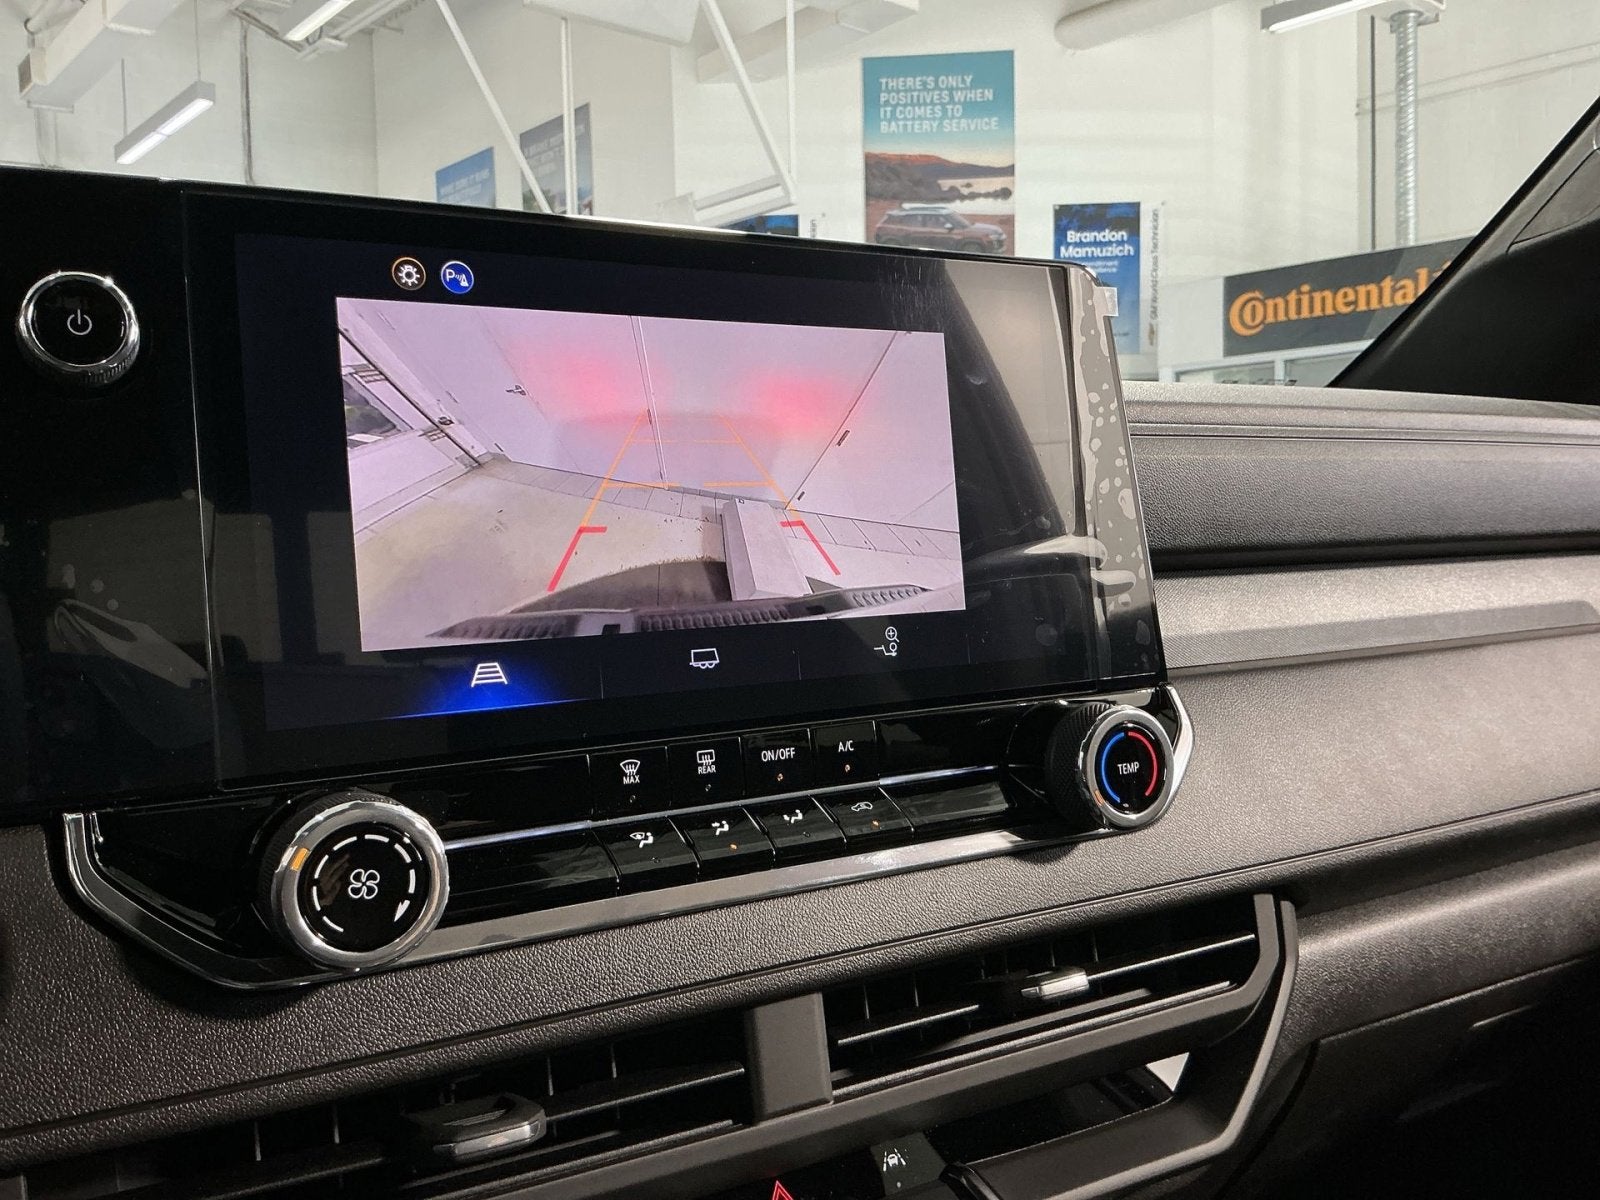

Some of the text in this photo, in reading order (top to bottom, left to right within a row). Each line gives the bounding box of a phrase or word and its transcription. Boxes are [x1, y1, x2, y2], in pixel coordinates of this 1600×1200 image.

[879, 74, 973, 91] THERE'S ONLY
[880, 88, 994, 105] POSITIVES WHEN
[880, 104, 963, 119] IT COMES TO
[880, 117, 1000, 134] BATTERY SERVICE
[1066, 229, 1128, 243] Brandon
[1060, 243, 1135, 258] Mamuzich
[1229, 266, 1430, 336] Continental
[838, 740, 855, 752] A/C
[761, 747, 795, 762] ON/OFF
[697, 764, 716, 775] REAR
[1117, 761, 1140, 775] TEMP
[623, 775, 640, 785] MAX
